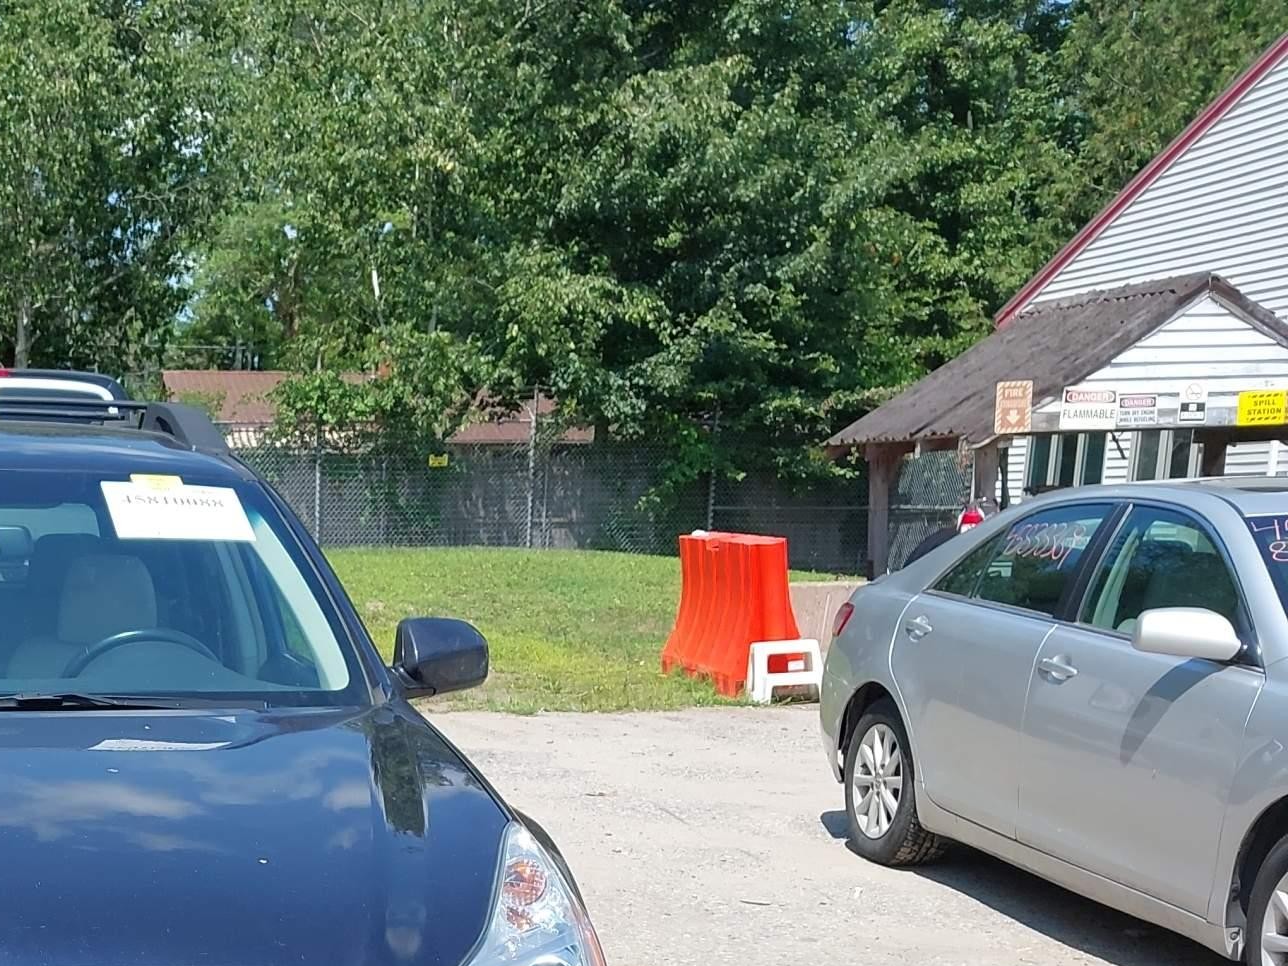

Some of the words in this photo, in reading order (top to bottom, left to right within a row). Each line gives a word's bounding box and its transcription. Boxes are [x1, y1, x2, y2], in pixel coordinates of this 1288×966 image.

[1004, 388, 1024, 398] FIRE
[1071, 391, 1109, 402] DANGER
[1124, 399, 1152, 407] DANGER
[1253, 399, 1275, 407] SPILL
[1062, 408, 1115, 419] FLAMMABLE
[1247, 407, 1282, 416] STATION
